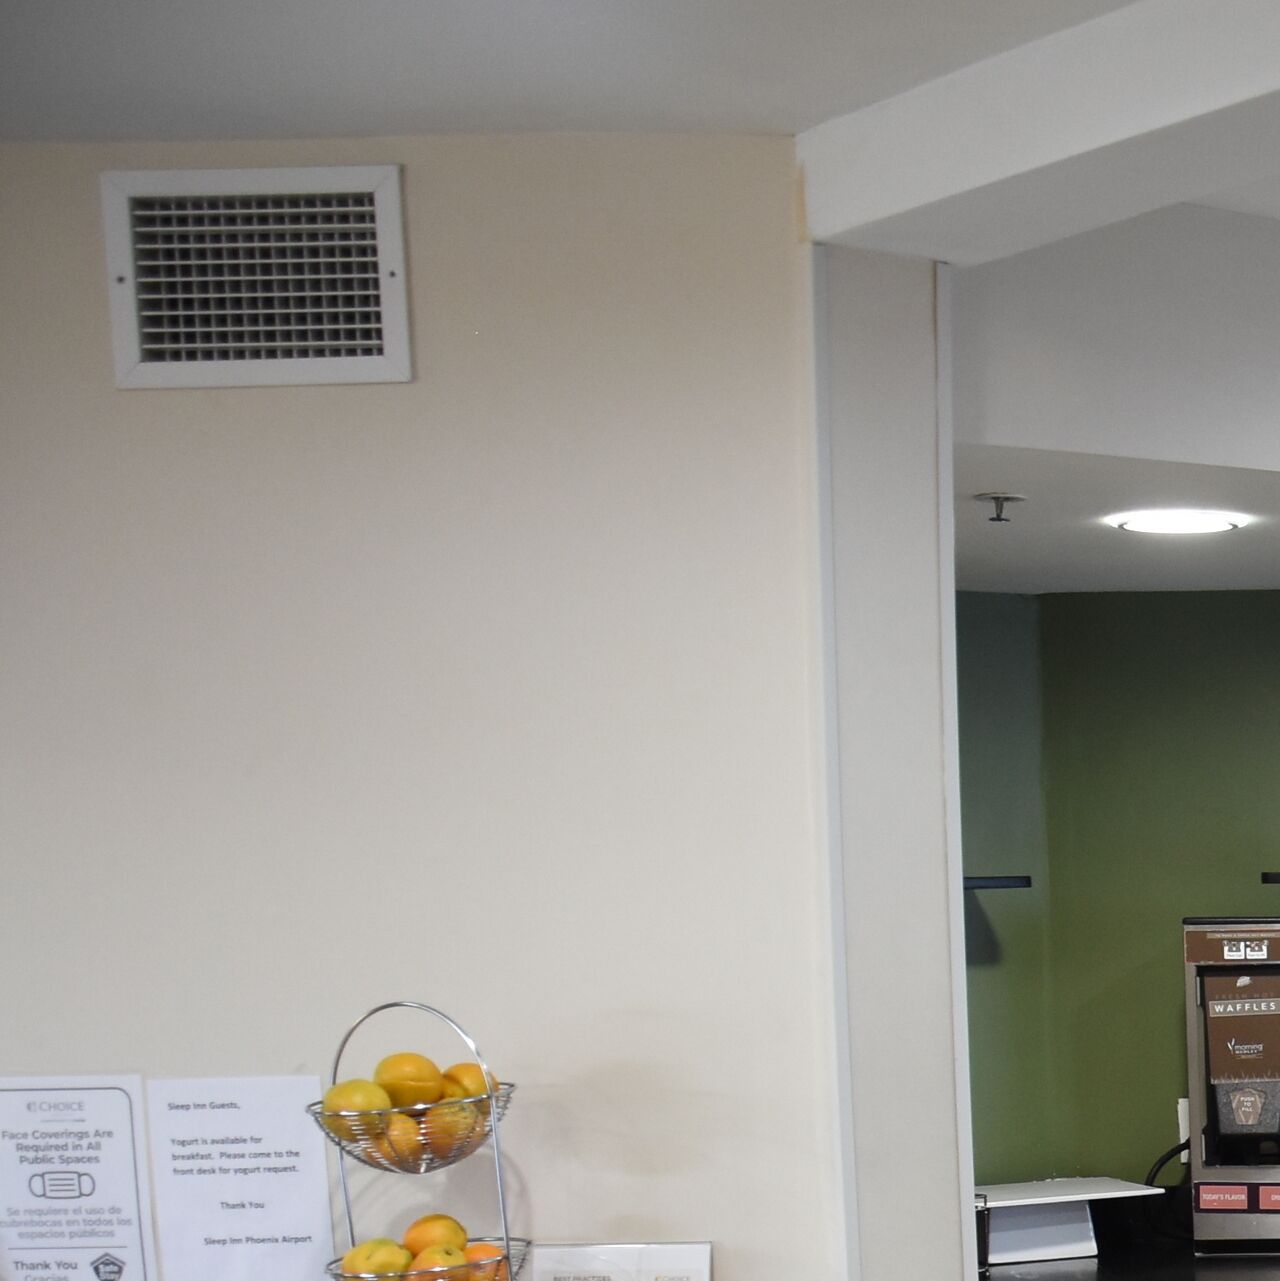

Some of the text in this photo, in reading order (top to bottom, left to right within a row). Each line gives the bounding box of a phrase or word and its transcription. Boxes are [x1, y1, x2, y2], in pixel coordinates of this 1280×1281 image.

[1214, 1002, 1276, 1013] WAFFLES
[39, 1101, 85, 1111] CHOICE
[168, 1102, 191, 1111] Sleep
[193, 1102, 207, 1110] Inn
[1, 1129, 114, 1141] Face Coverings Are
[171, 1135, 263, 1147] Yogurt is available for
[16, 1141, 101, 1153] Required in All
[19, 1154, 100, 1166] Public Spaces
[219, 1151, 246, 1159] Please
[248, 1151, 271, 1159] come
[285, 1150, 300, 1158] the
[172, 1167, 194, 1175] front
[196, 1166, 216, 1175] desk
[219, 1166, 231, 1174] for
[233, 1165, 261, 1175] yogurt
[220, 1201, 265, 1209] Thank You
[203, 1237, 227, 1246] Sleep
[245, 1236, 279, 1244] Phoenix
[281, 1235, 312, 1244] Airport
[13, 1259, 78, 1270] Thank You
